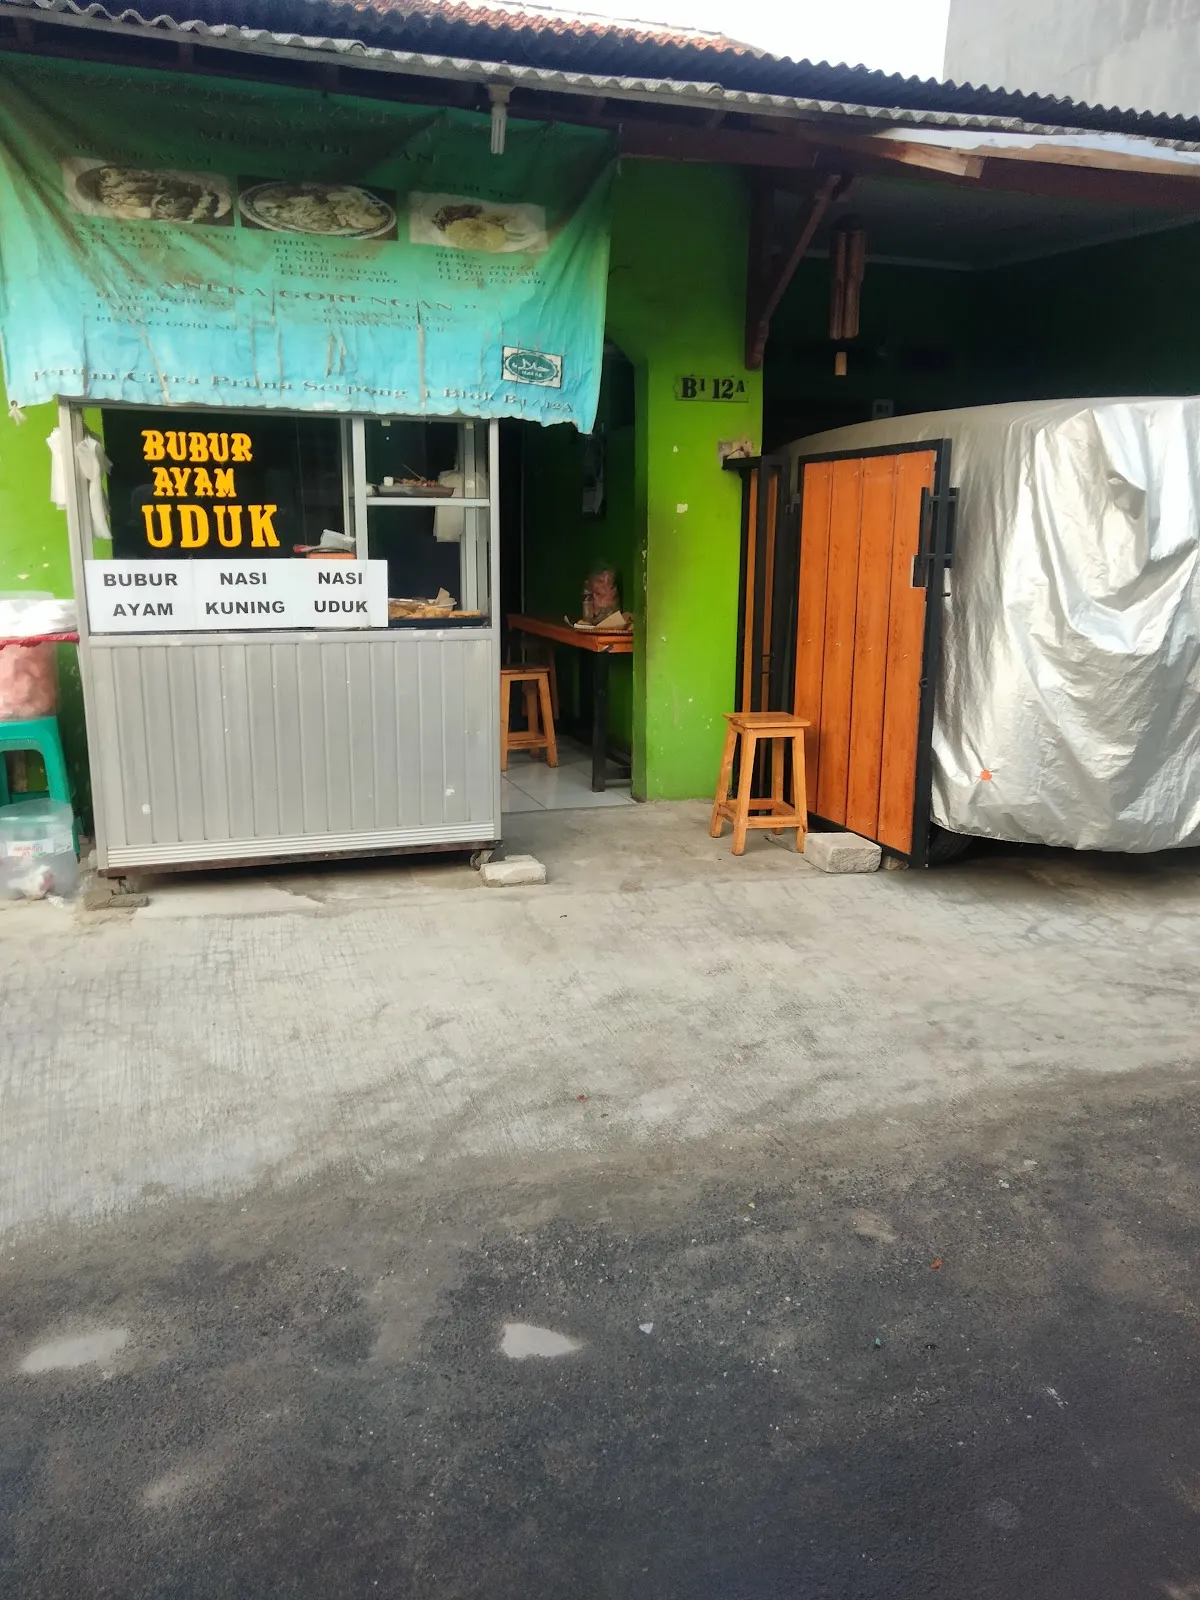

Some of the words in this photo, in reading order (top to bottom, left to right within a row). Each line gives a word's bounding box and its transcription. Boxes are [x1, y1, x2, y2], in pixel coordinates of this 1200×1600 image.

[334, 266, 389, 277] DADAR
[164, 281, 269, 298] ANEKA
[278, 290, 453, 312] GORENGAN
[126, 371, 200, 385] Citra
[211, 375, 293, 391] Prima
[302, 381, 409, 402] Serpong
[443, 387, 495, 402] Blok
[141, 430, 253, 463] BUBUR
[152, 466, 238, 498] AYAM
[141, 504, 280, 548] UDUK
[103, 573, 178, 587] BUBUR
[220, 571, 267, 586] NASI
[318, 571, 363, 586] NASI
[113, 602, 174, 617] AYAM
[205, 600, 285, 616] KUNING
[314, 600, 368, 614] UDUK
